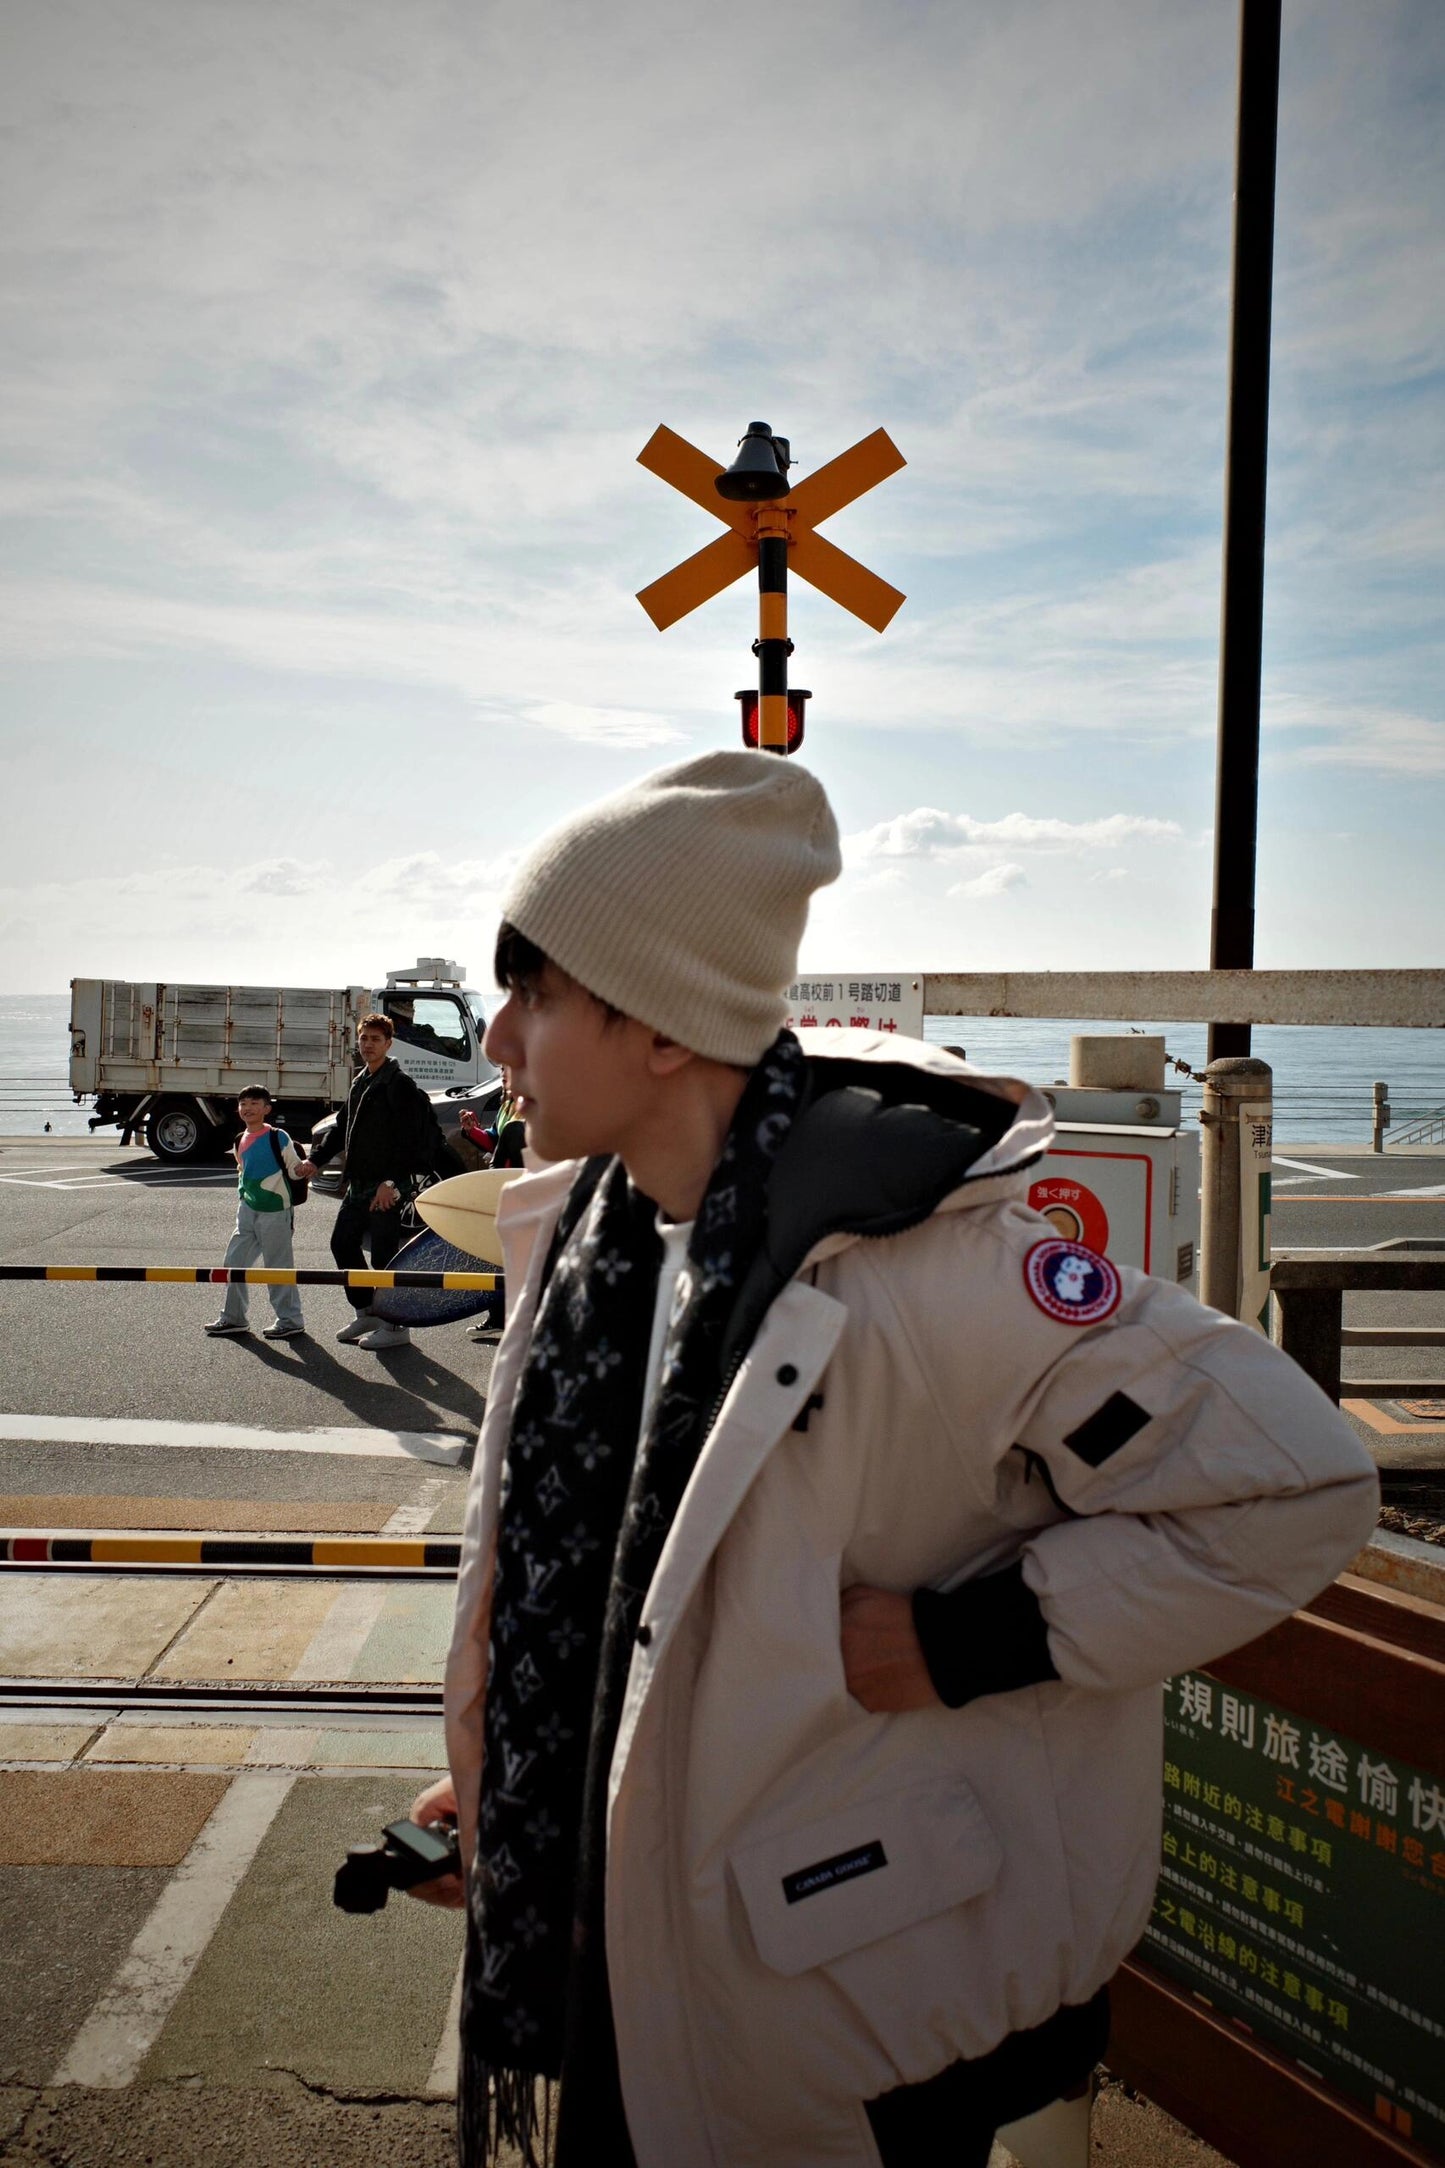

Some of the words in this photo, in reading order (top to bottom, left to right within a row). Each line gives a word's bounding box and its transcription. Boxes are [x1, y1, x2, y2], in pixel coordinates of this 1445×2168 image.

[784, 982, 902, 1002] 倉高校前1号踏切道
[1037, 1186, 1081, 1201] 強く押す
[1161, 1675, 1445, 1842] 規則旅途愉快
[1163, 1760, 1333, 1868] 路附近的注意事項
[1162, 1830, 1305, 1929] 台上的注意事項
[1150, 1897, 1349, 2032] 之電沿線的注意事項
